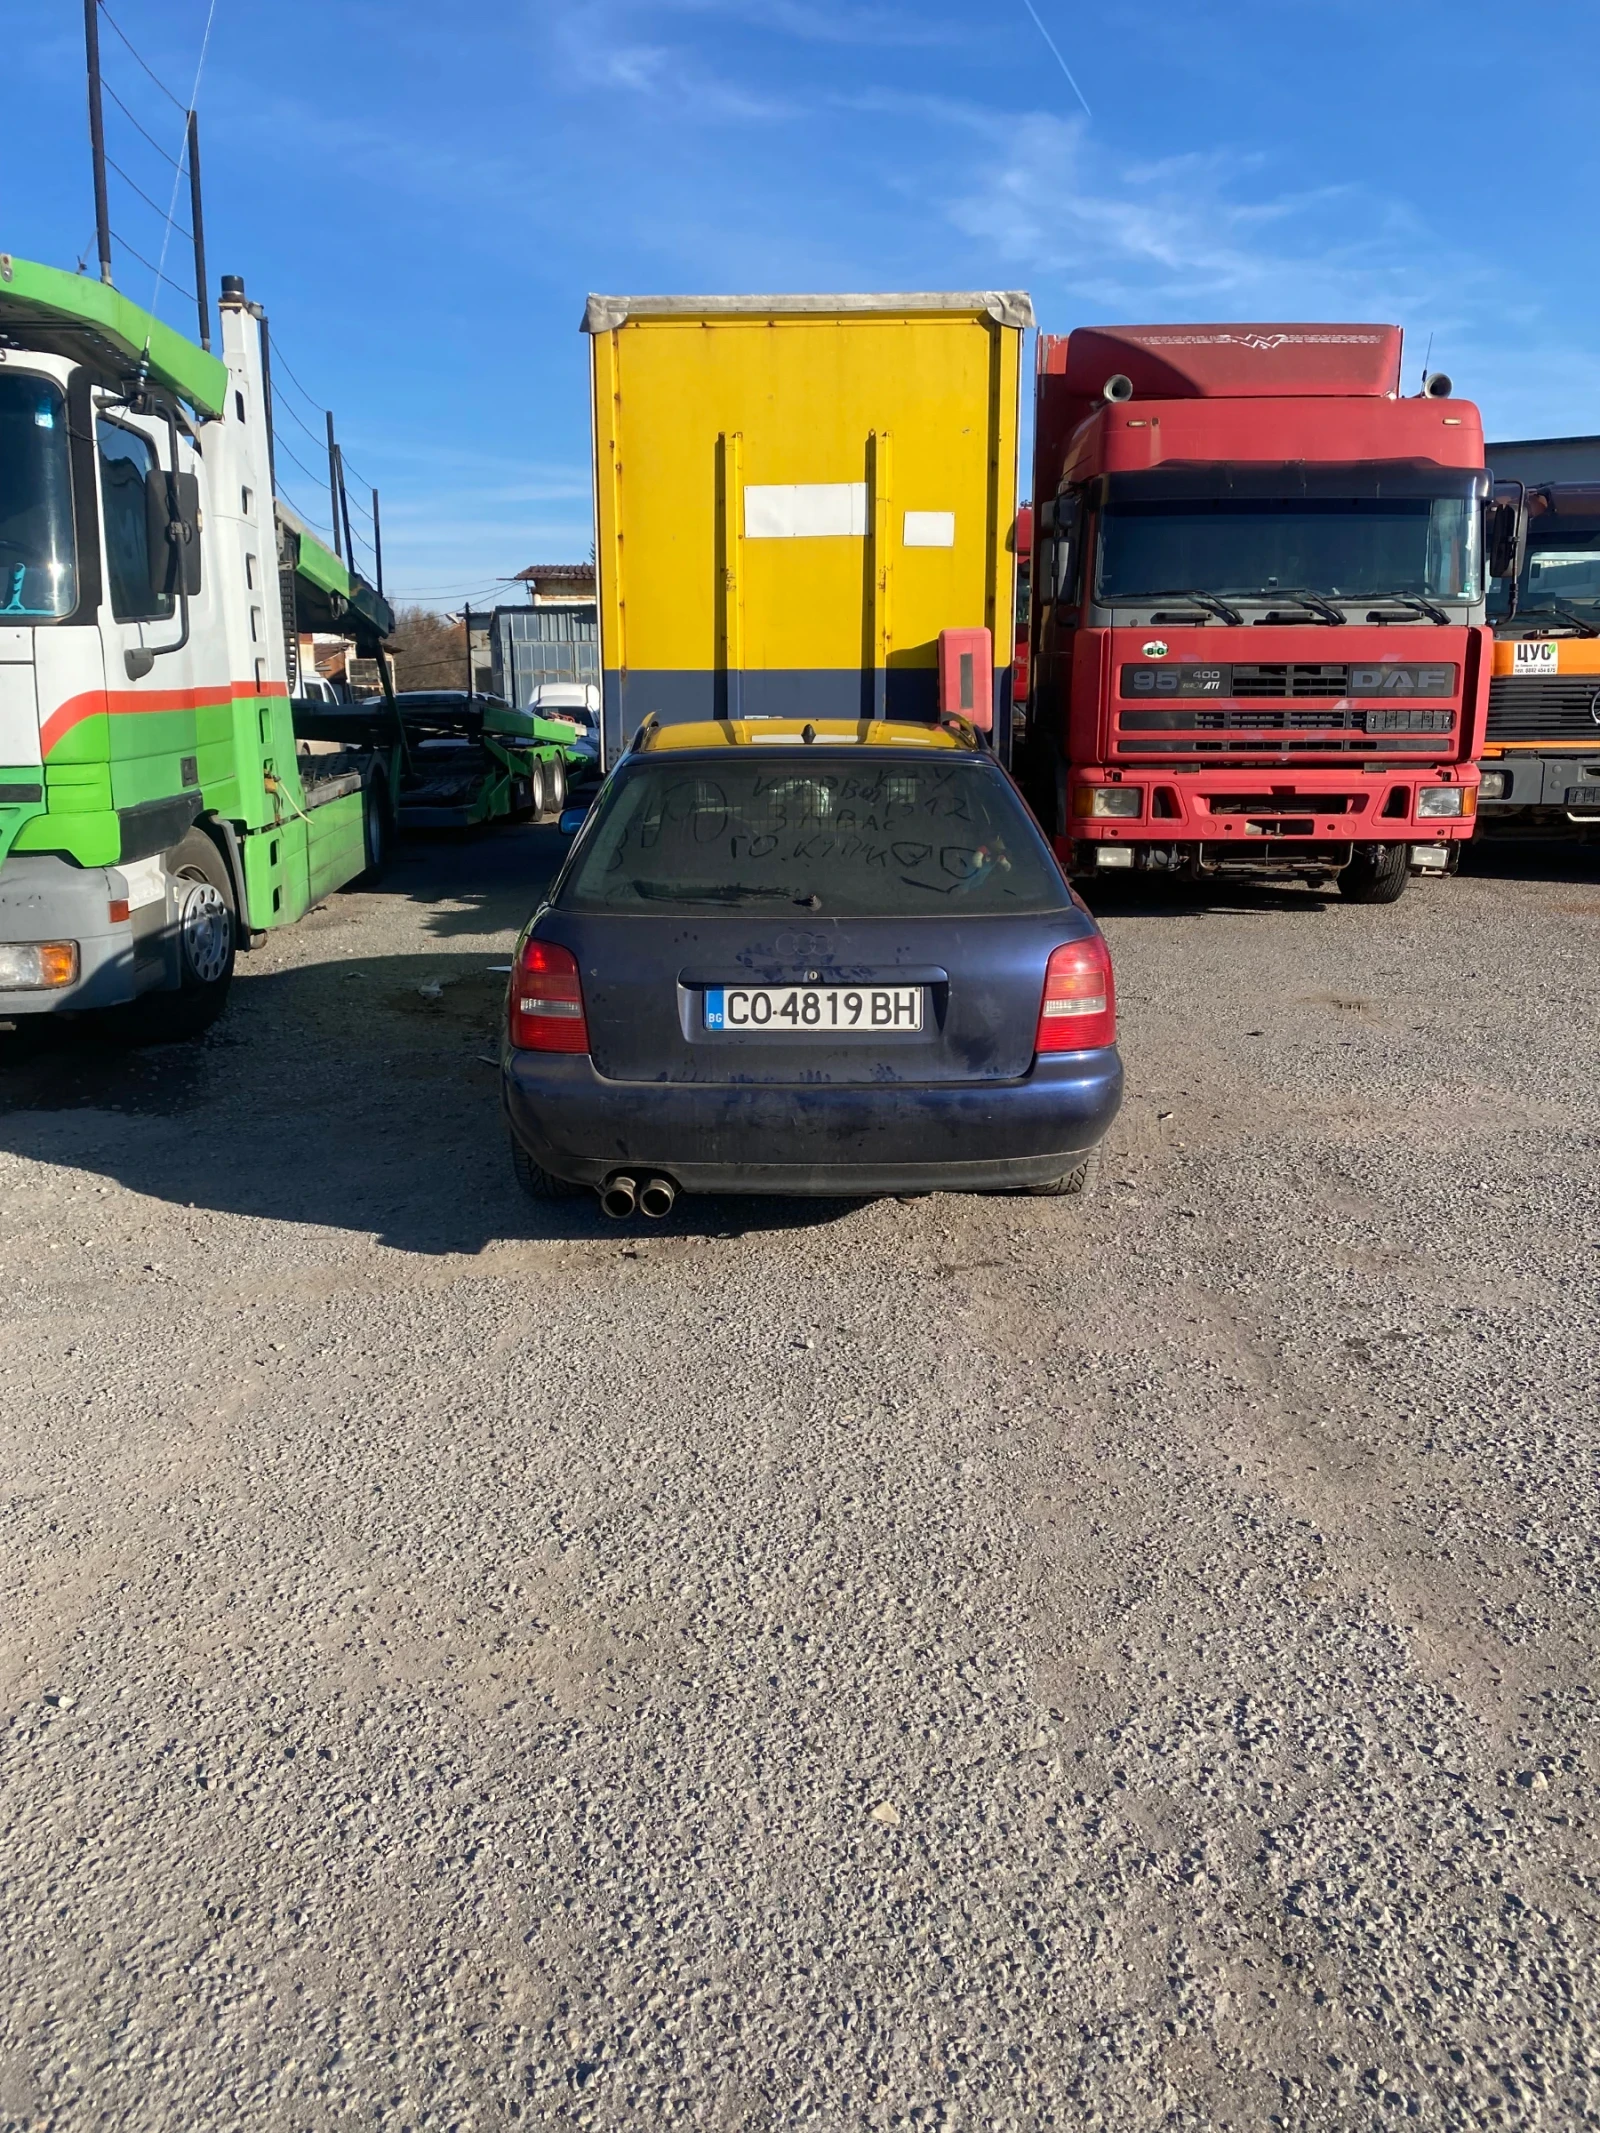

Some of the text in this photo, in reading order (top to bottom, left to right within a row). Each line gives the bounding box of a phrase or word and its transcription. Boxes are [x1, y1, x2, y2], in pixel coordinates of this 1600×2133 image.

[1146, 647, 1165, 655] BG
[1192, 670, 1220, 679] 400
[1352, 670, 1445, 688] DAF
[1133, 671, 1177, 690] 95
[708, 1012, 723, 1023] BG
